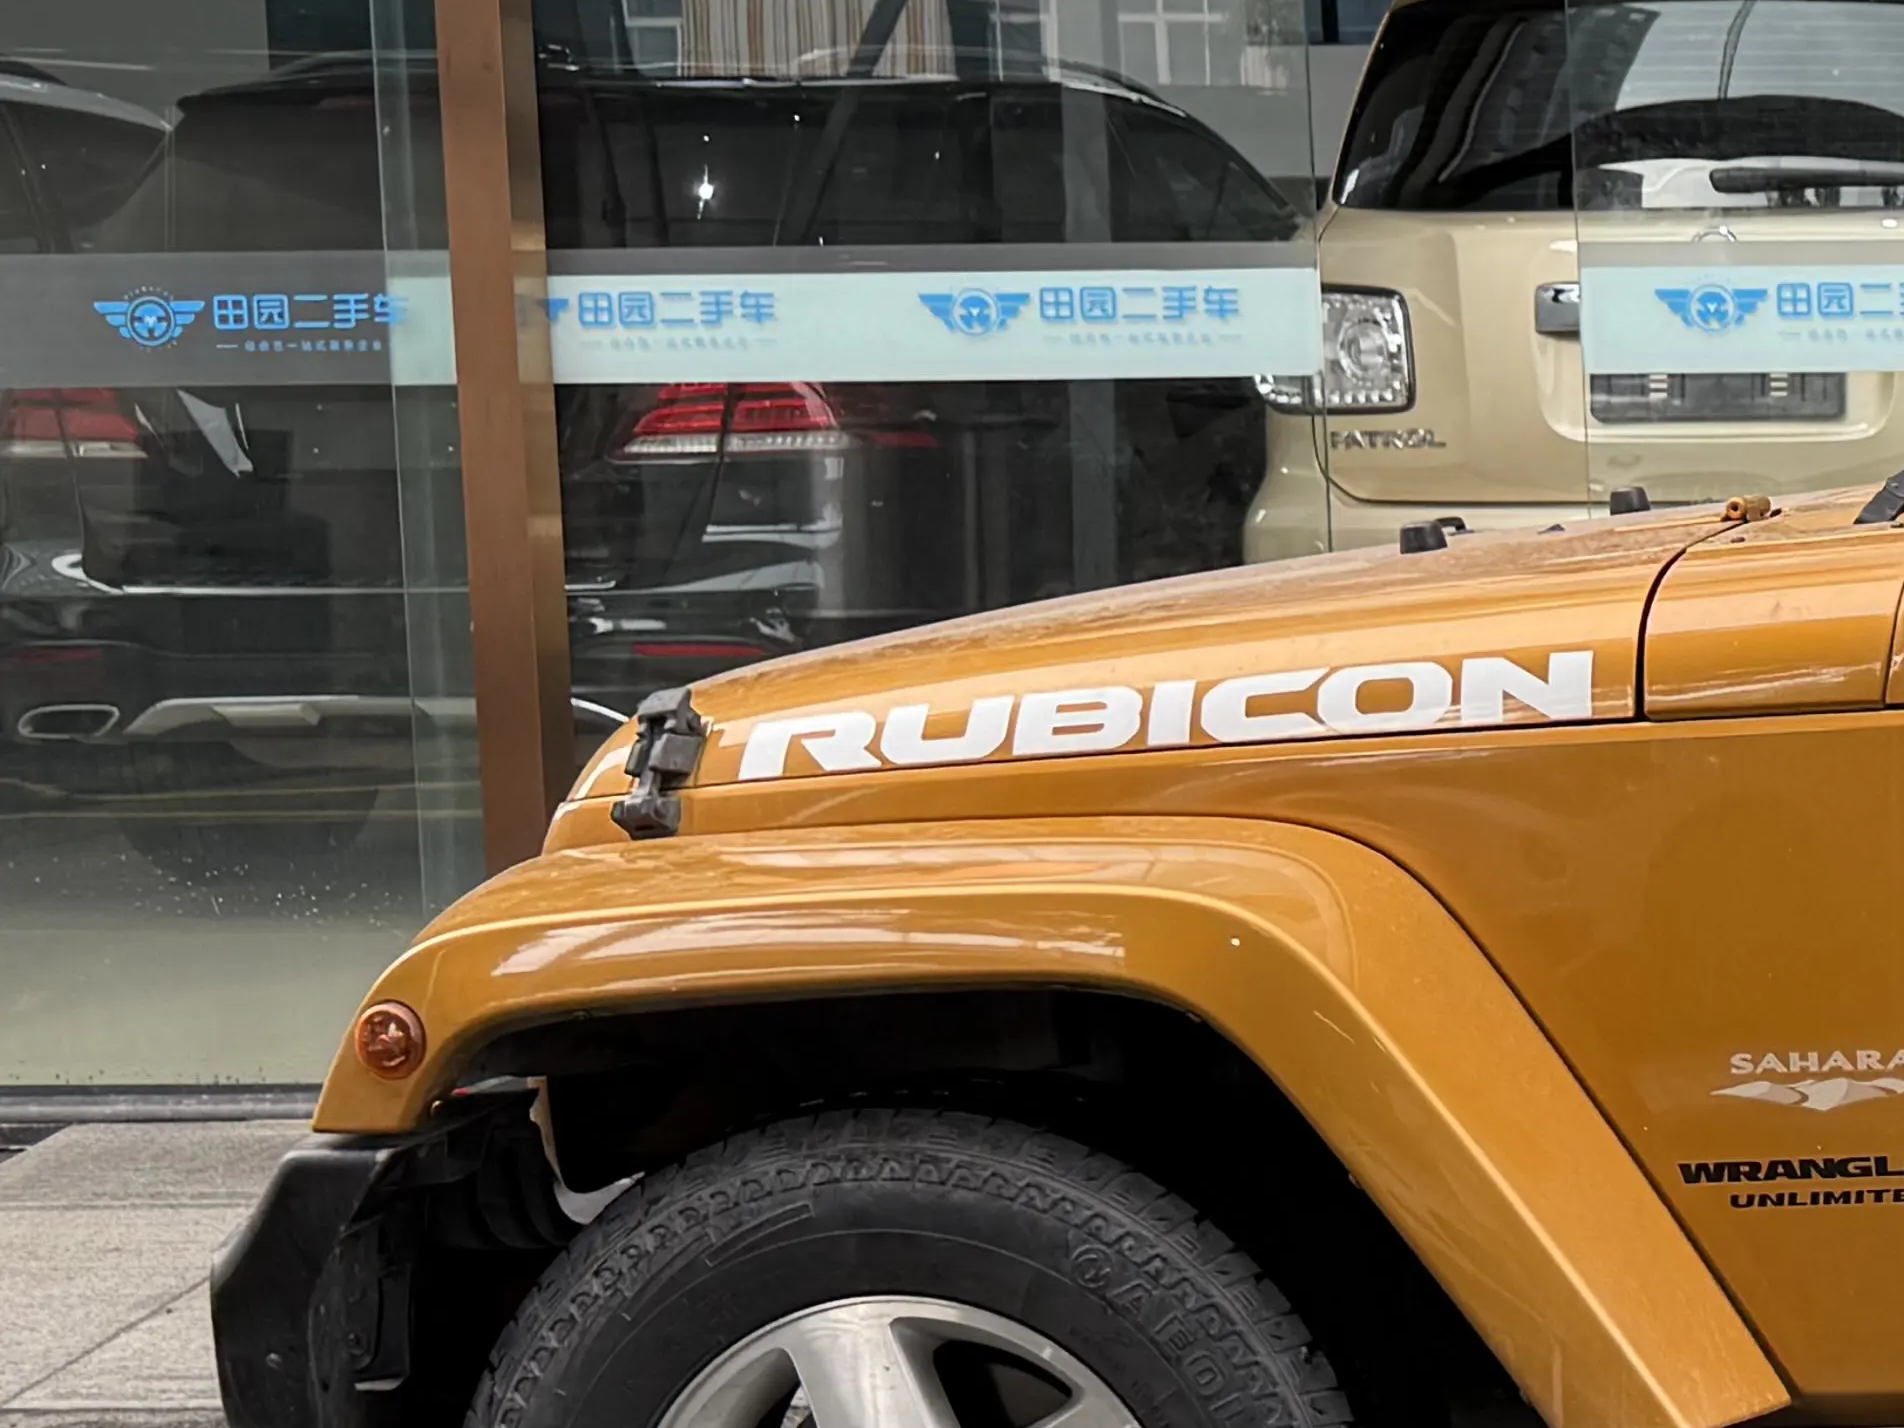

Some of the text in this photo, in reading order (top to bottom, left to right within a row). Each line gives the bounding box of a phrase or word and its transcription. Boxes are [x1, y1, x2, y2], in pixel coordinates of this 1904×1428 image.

[212, 293, 409, 330] 田园二手车
[577, 289, 776, 328] 田园二手车
[1039, 285, 1240, 323] 田园二手车
[1329, 427, 1448, 451] PATROL
[736, 649, 1594, 780] RUBICON
